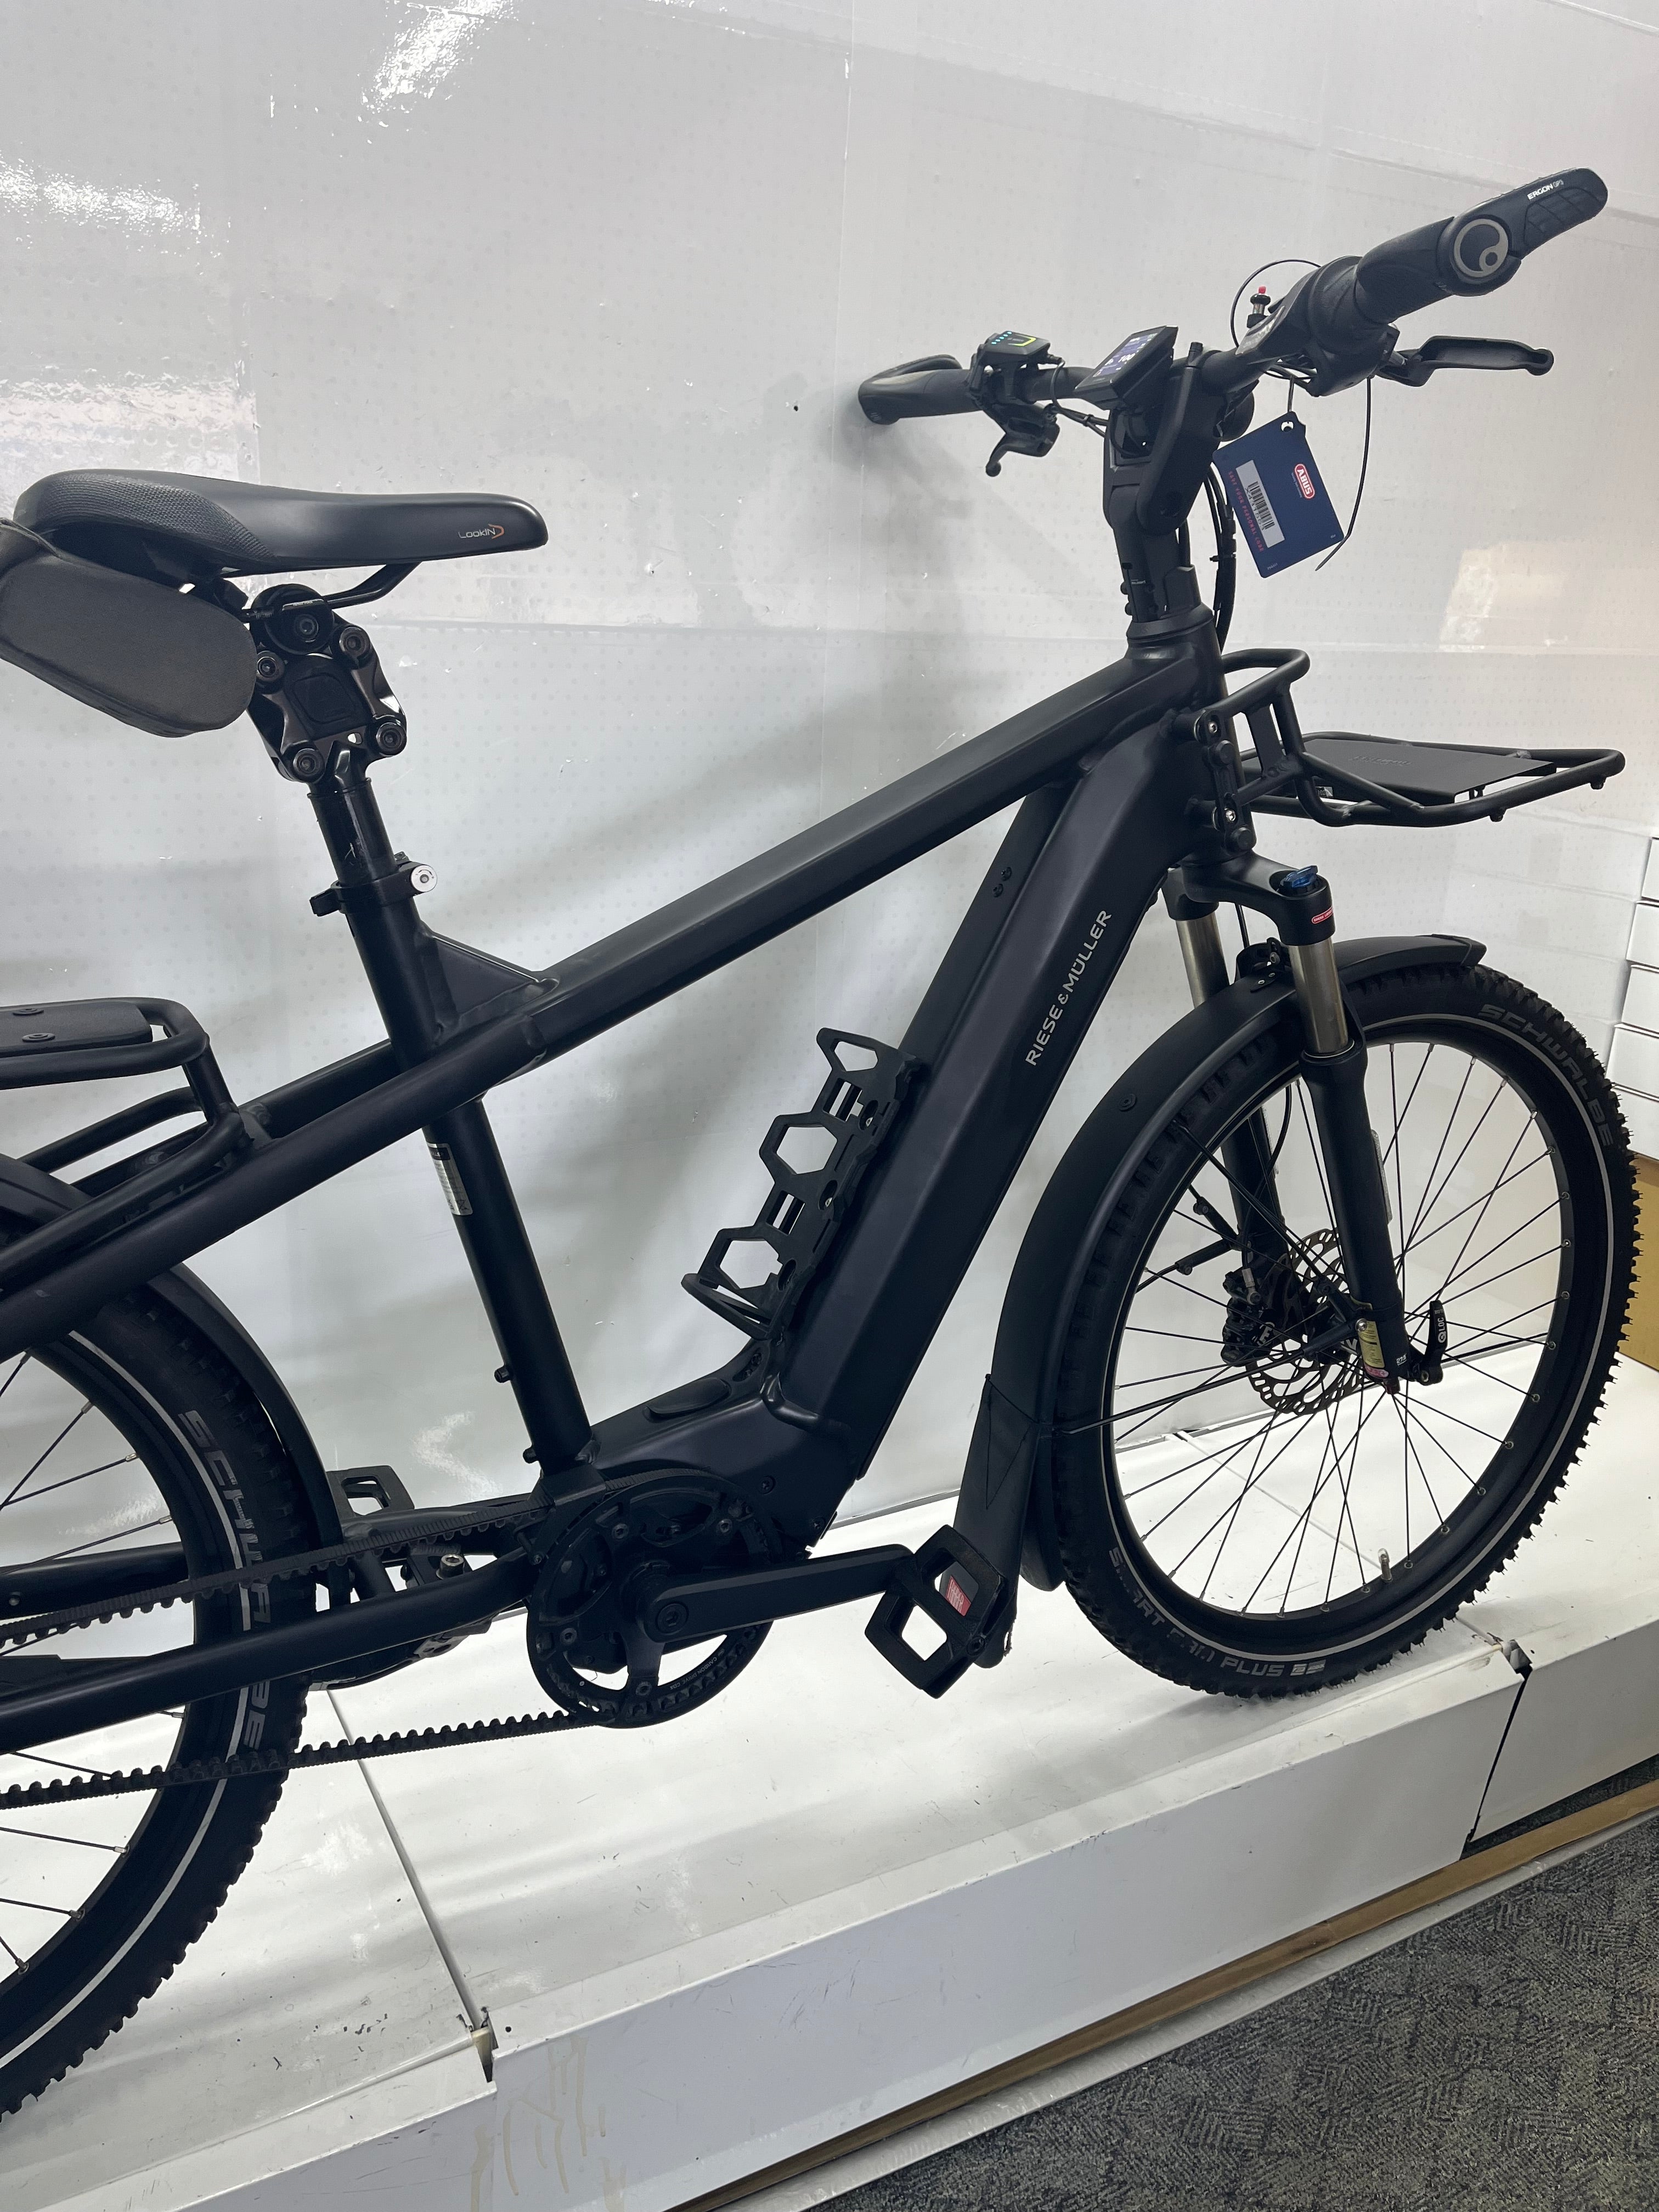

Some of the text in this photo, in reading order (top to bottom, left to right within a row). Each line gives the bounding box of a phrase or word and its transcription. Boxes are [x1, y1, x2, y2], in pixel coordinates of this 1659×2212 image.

[1527, 183, 1554, 200] ERGON
[1297, 469, 1313, 495] ABUS
[1025, 910, 1113, 1066] RIESE & MÜLLER
[1478, 1003, 1614, 1146] SCHWALBE
[697, 1656, 718, 1675] CARBON
[1220, 1656, 1285, 1677] PLUS
